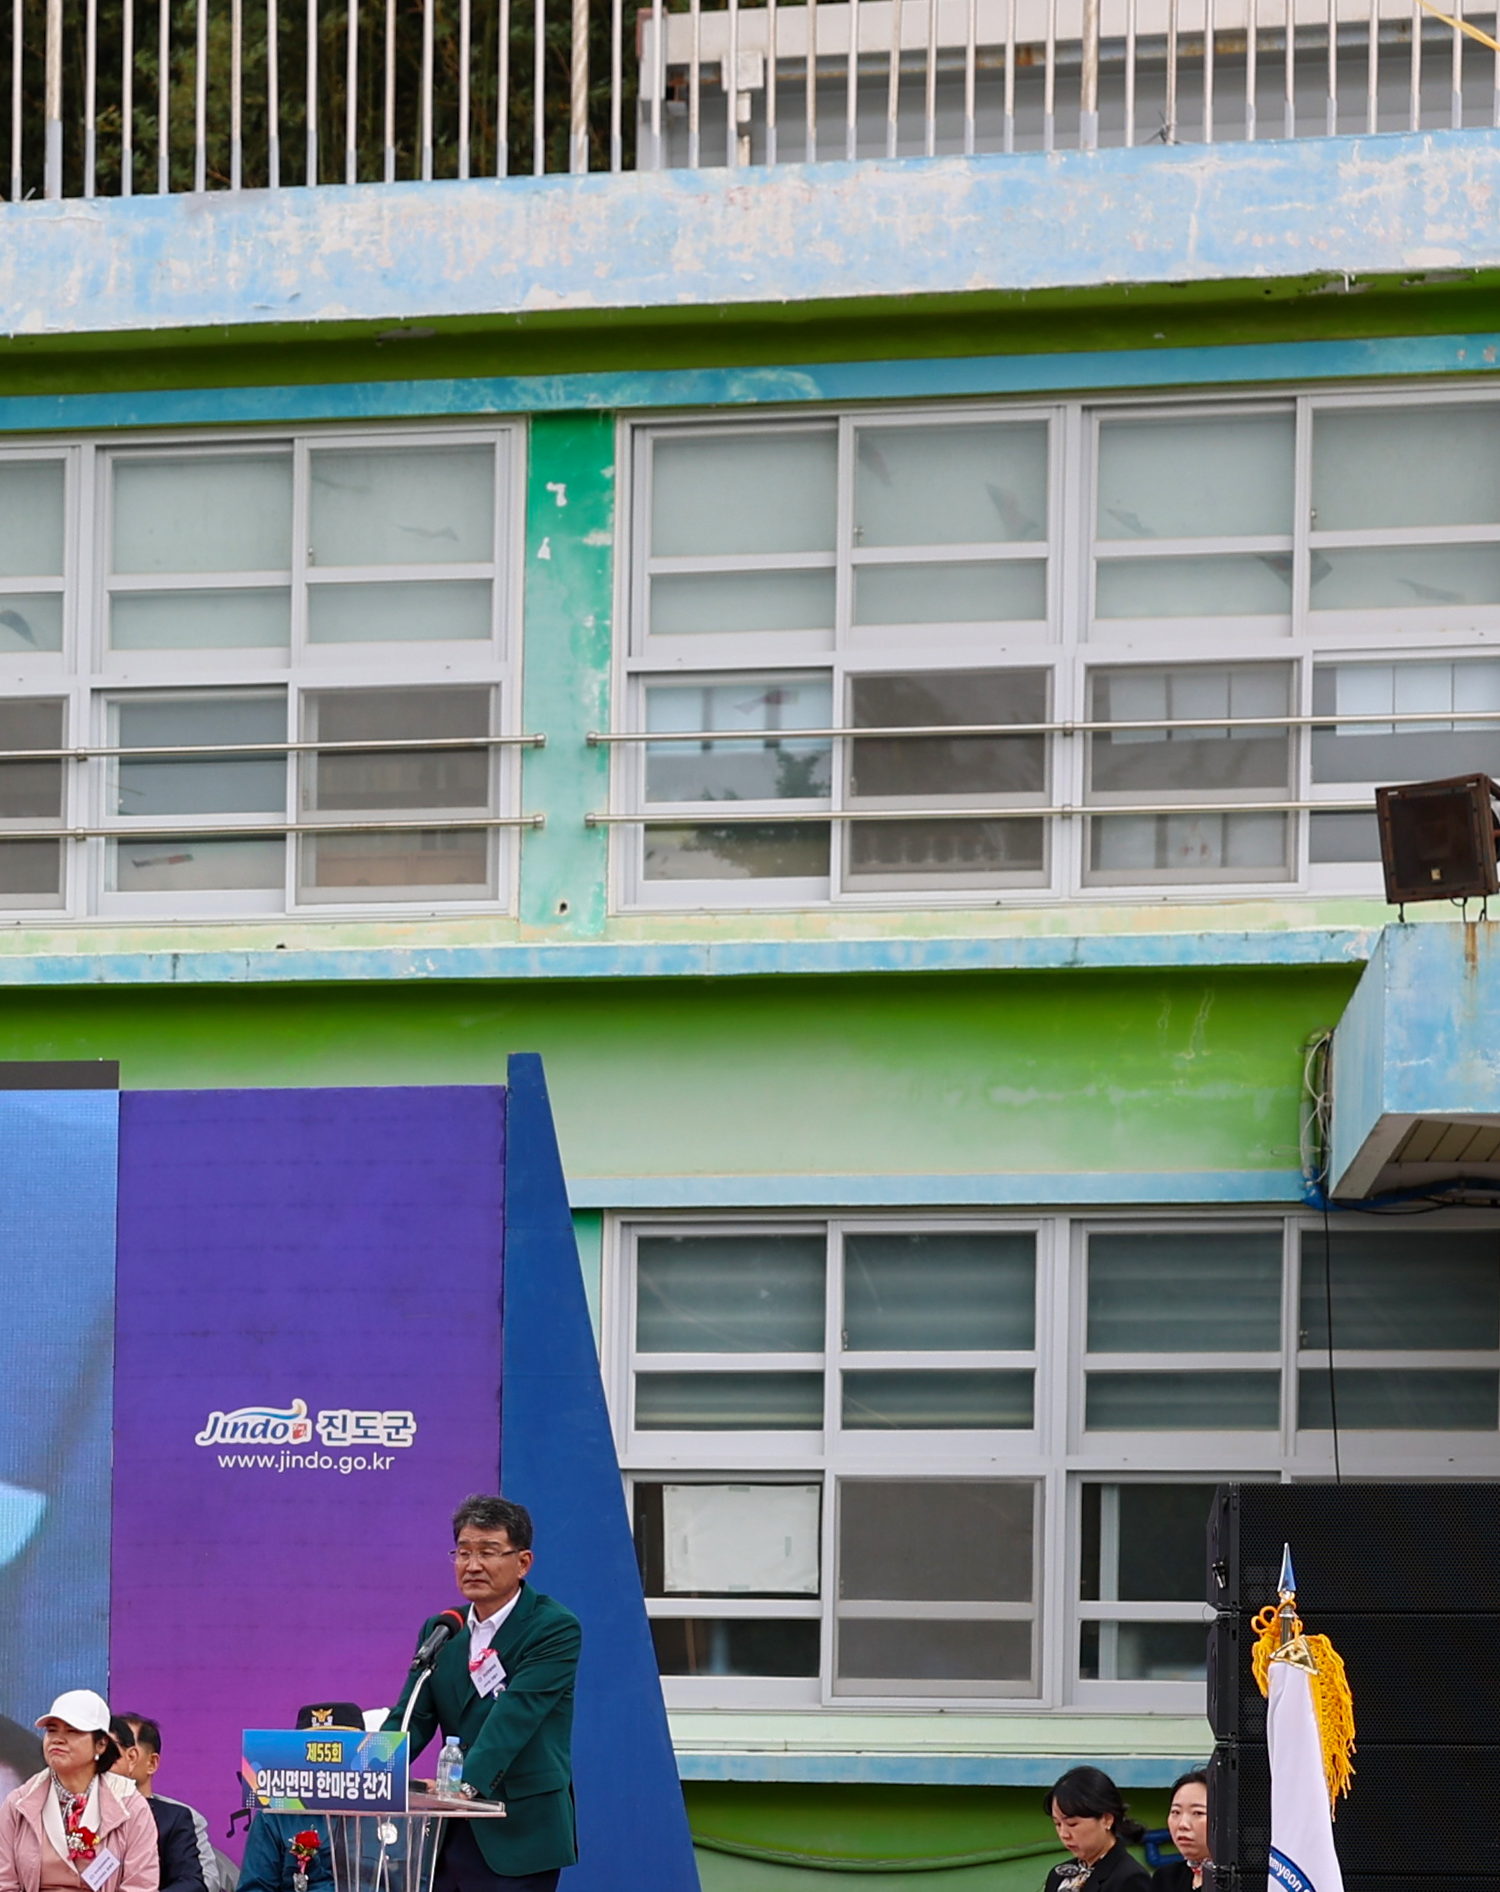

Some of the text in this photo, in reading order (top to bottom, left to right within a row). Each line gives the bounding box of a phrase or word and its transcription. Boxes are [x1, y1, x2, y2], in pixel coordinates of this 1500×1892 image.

[198, 1410, 412, 1443] Jindo 진도군
[217, 1450, 396, 1474] www.jindo.go.kr
[306, 1742, 343, 1763] 제55회
[256, 1769, 392, 1801] 의신면민 한마당 잔치
